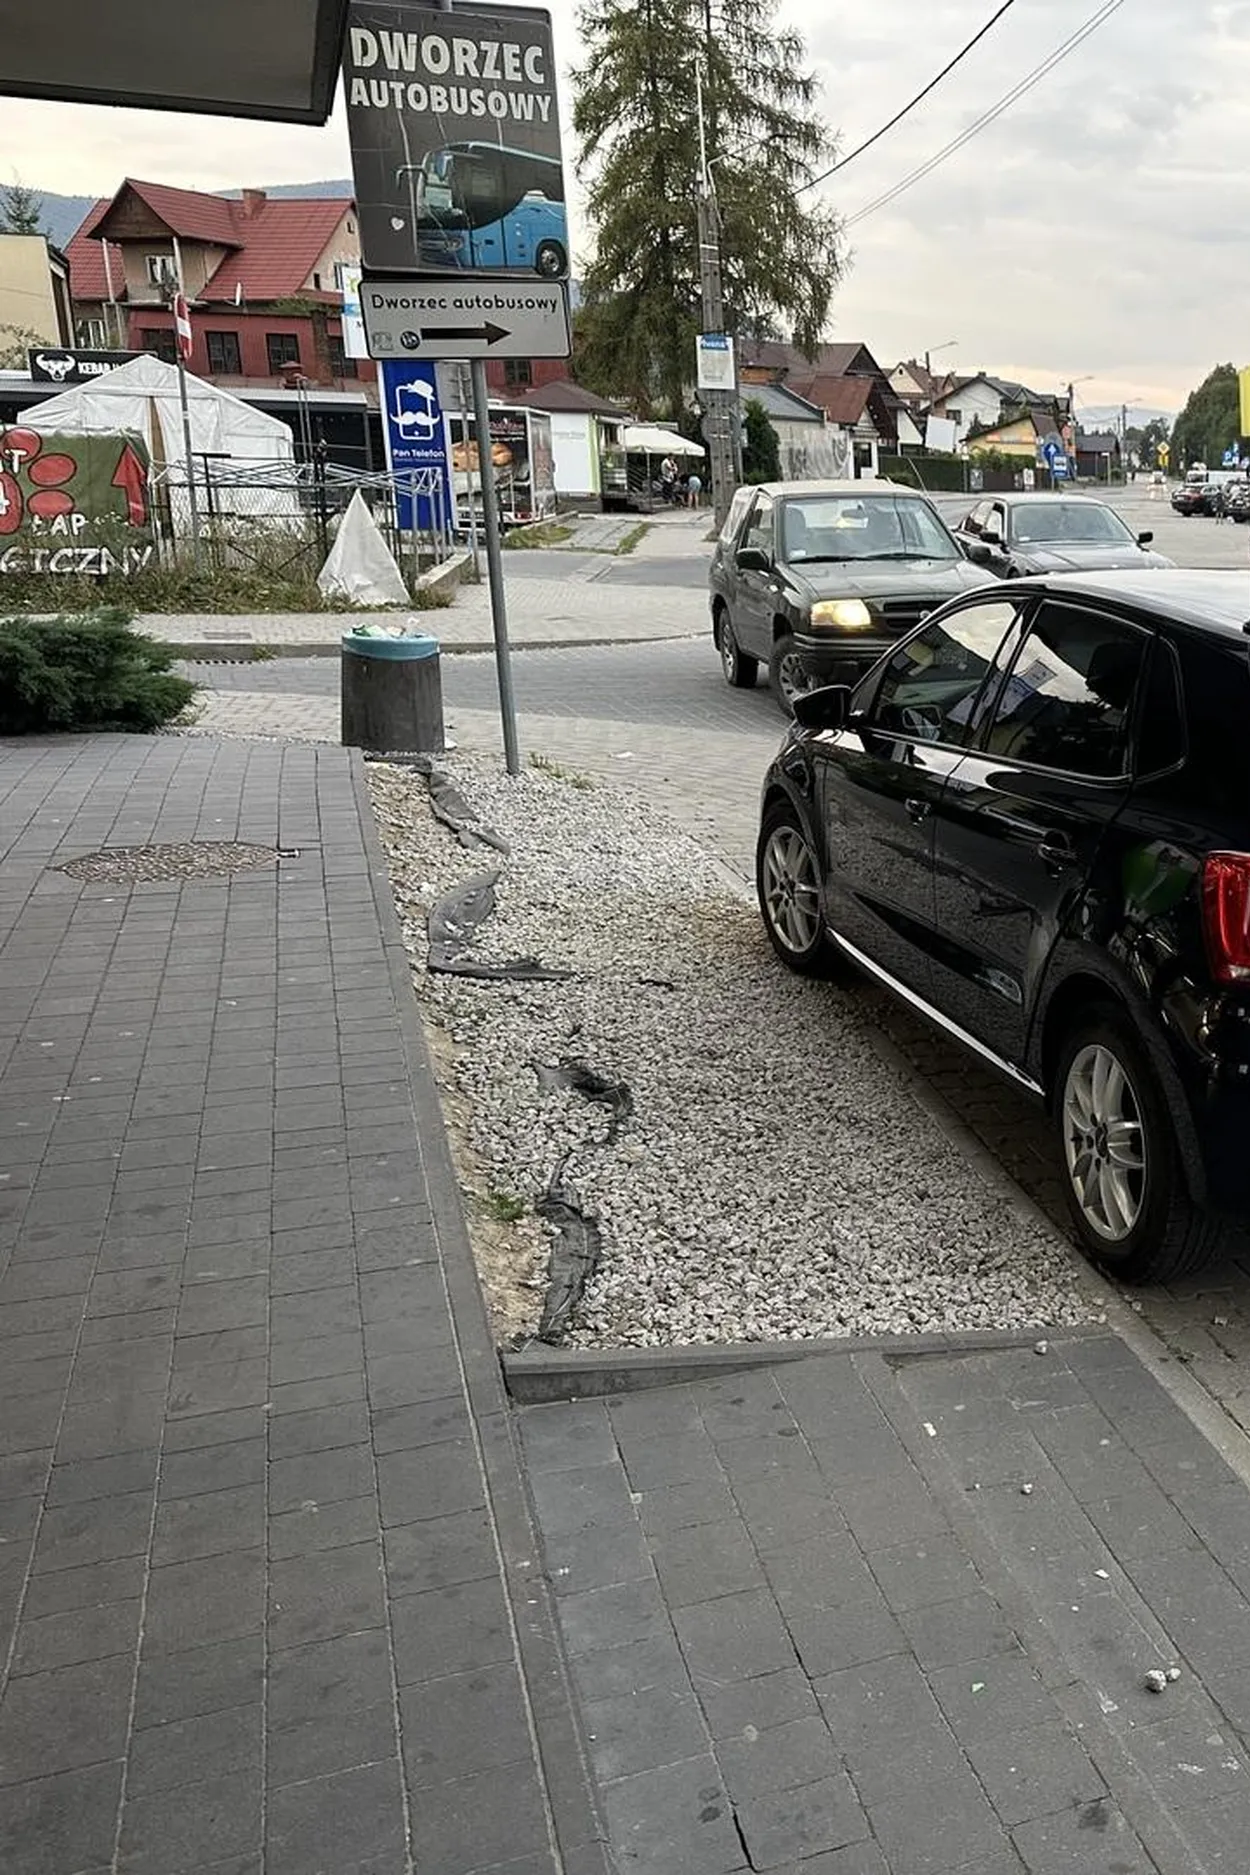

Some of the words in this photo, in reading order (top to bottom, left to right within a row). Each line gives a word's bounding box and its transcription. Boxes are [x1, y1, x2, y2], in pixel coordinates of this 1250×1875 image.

[350, 26, 545, 84] DWORZEC
[350, 77, 551, 122] AUTOBUSOWY
[371, 294, 448, 309] Dworzec
[452, 294, 558, 314] autobusowy
